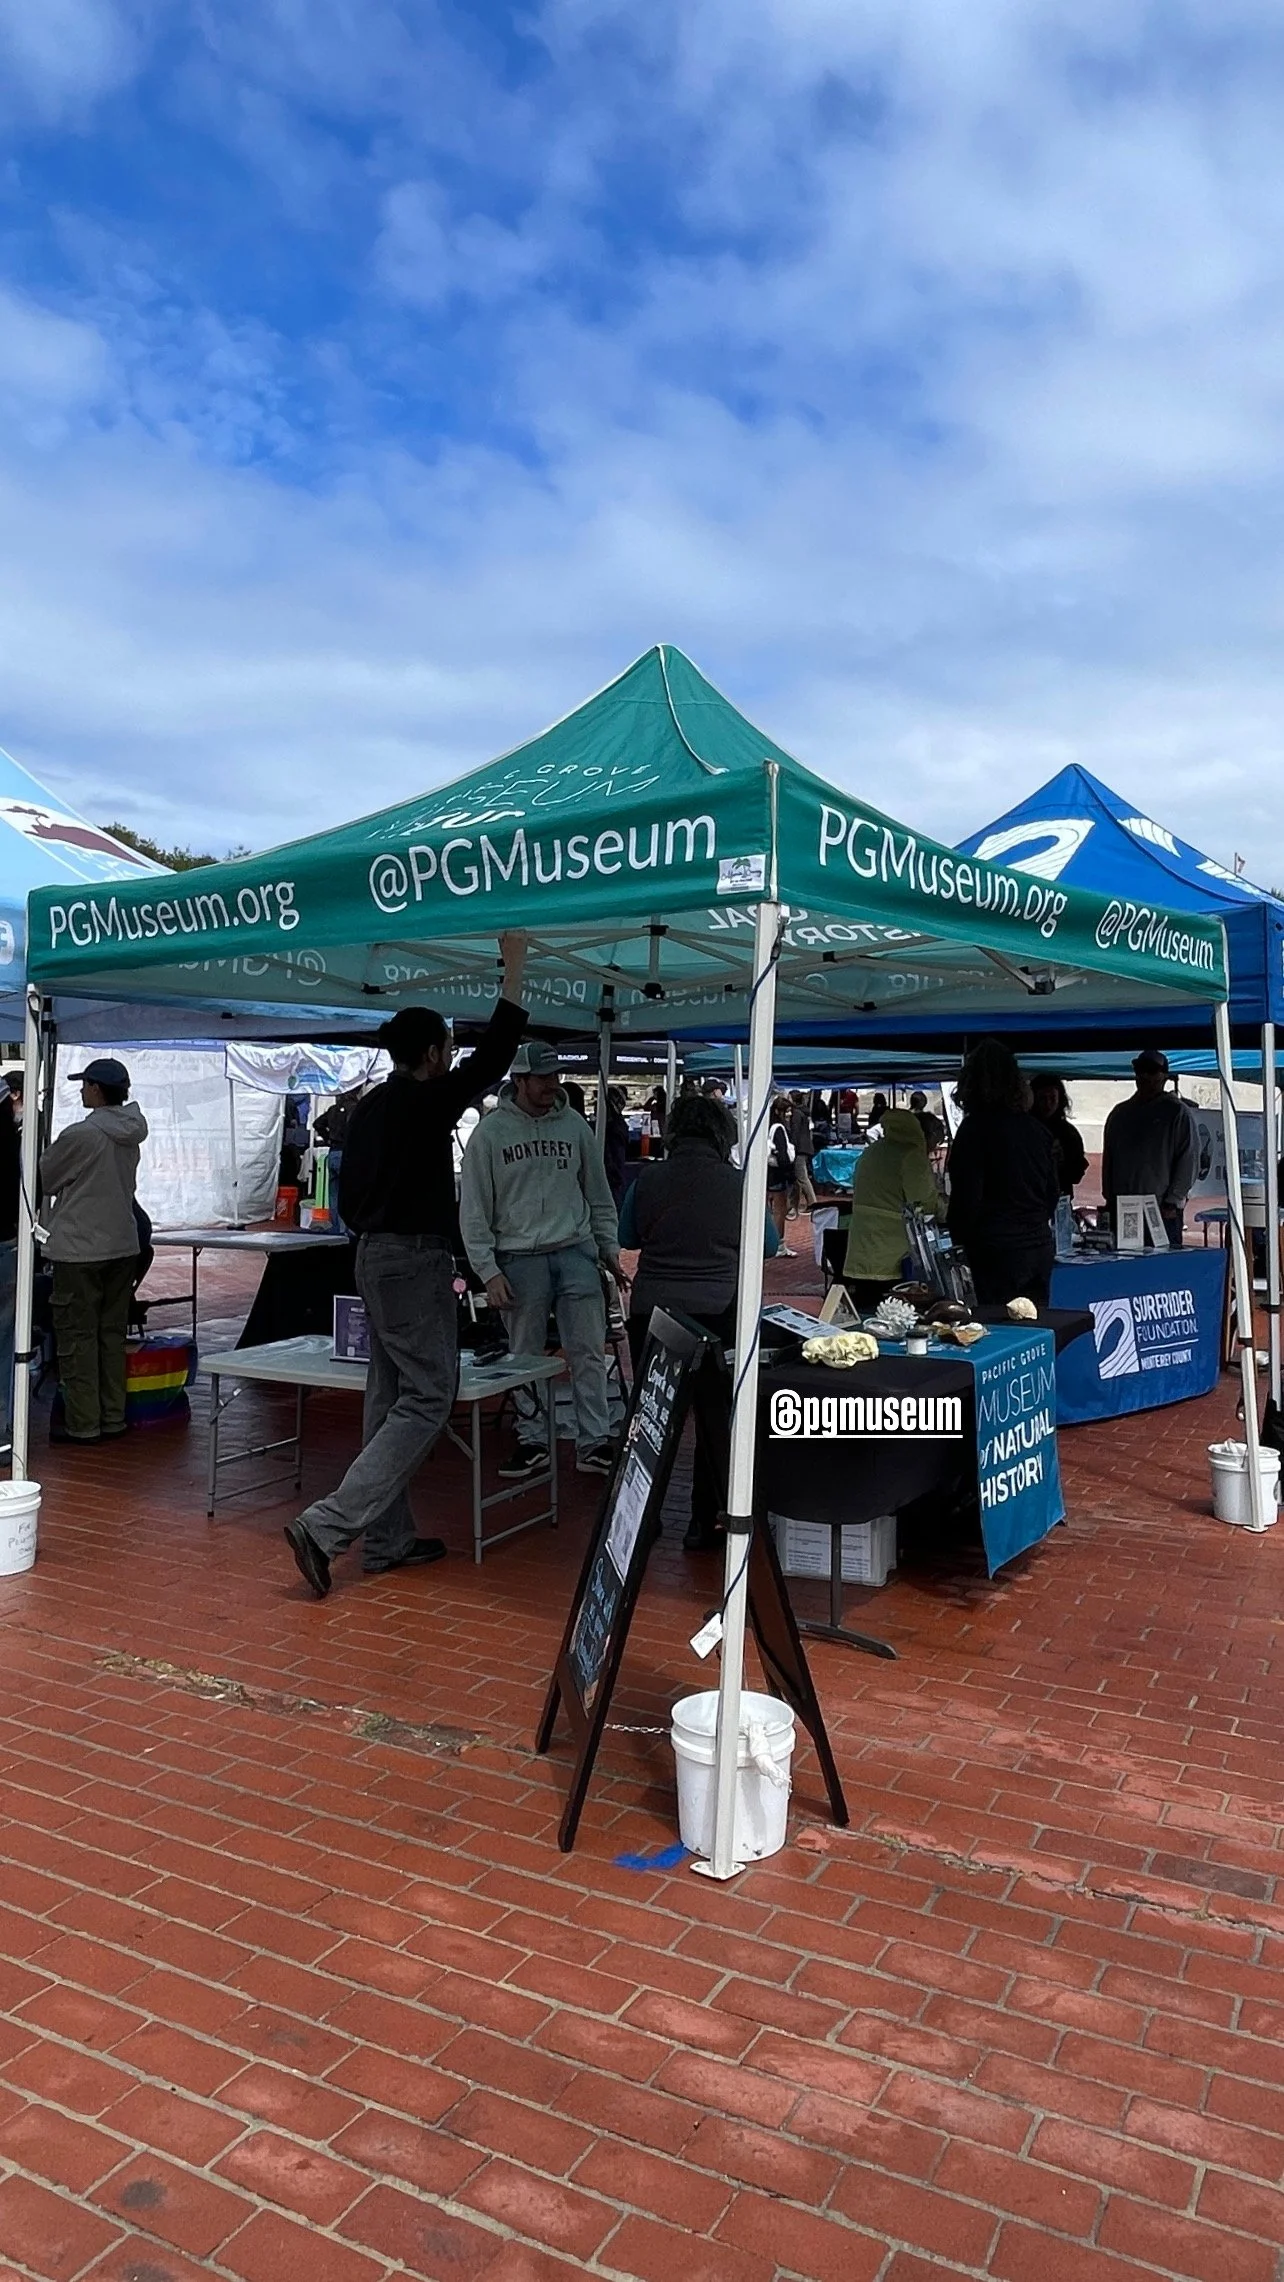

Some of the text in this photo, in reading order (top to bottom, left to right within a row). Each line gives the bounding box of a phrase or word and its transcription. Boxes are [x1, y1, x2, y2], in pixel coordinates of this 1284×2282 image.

[369, 815, 716, 913] @PGMuseum
[819, 803, 1068, 938] PGMuseum.org
[50, 881, 300, 949] PGMuseum.org
[1095, 900, 1214, 971] @PGMuseum
[502, 1140, 572, 1165] MONTEREY
[557, 1159, 568, 1170] CA
[1132, 1289, 1195, 1323] SURFRIDER
[1136, 1318, 1197, 1342] FOUNDATION
[982, 1343, 1047, 1384] PACIFIC GROVE
[977, 1361, 1057, 1432] MUSEUM
[980, 1408, 1055, 1469] of NATURAL
[980, 1452, 1044, 1511] HISTORY
